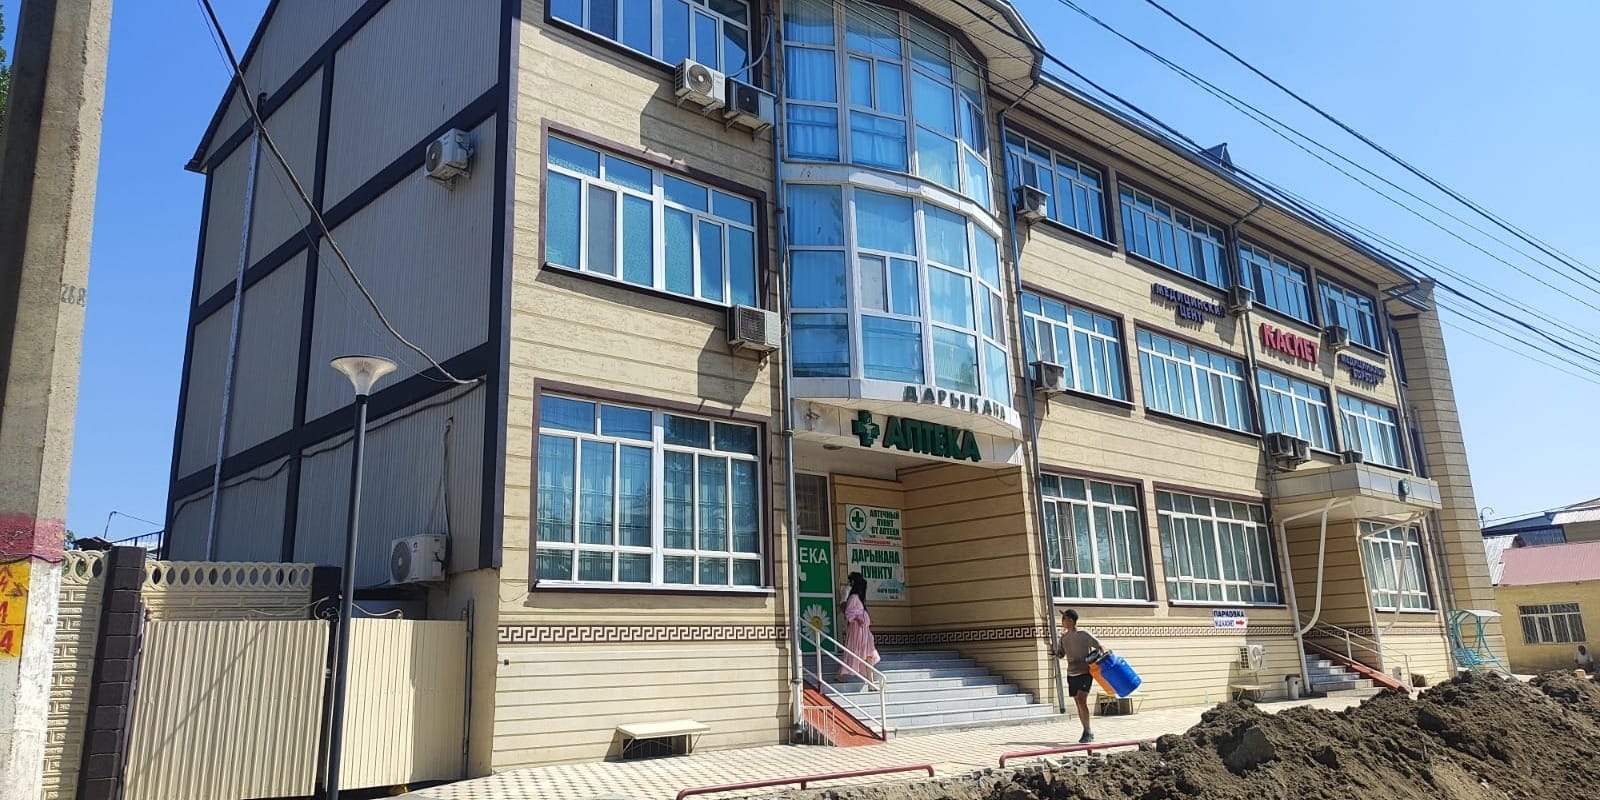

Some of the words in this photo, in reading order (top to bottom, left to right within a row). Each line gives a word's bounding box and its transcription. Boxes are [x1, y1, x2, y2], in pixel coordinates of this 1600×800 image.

[1260, 323, 1318, 363] КАСИЕТ
[903, 386, 1006, 421] ДАРЫКАНА
[883, 415, 981, 462] АПТЕКА
[852, 549, 900, 564] ДАРЫКАНА
[1213, 610, 1244, 618] ПАРКОВКА
